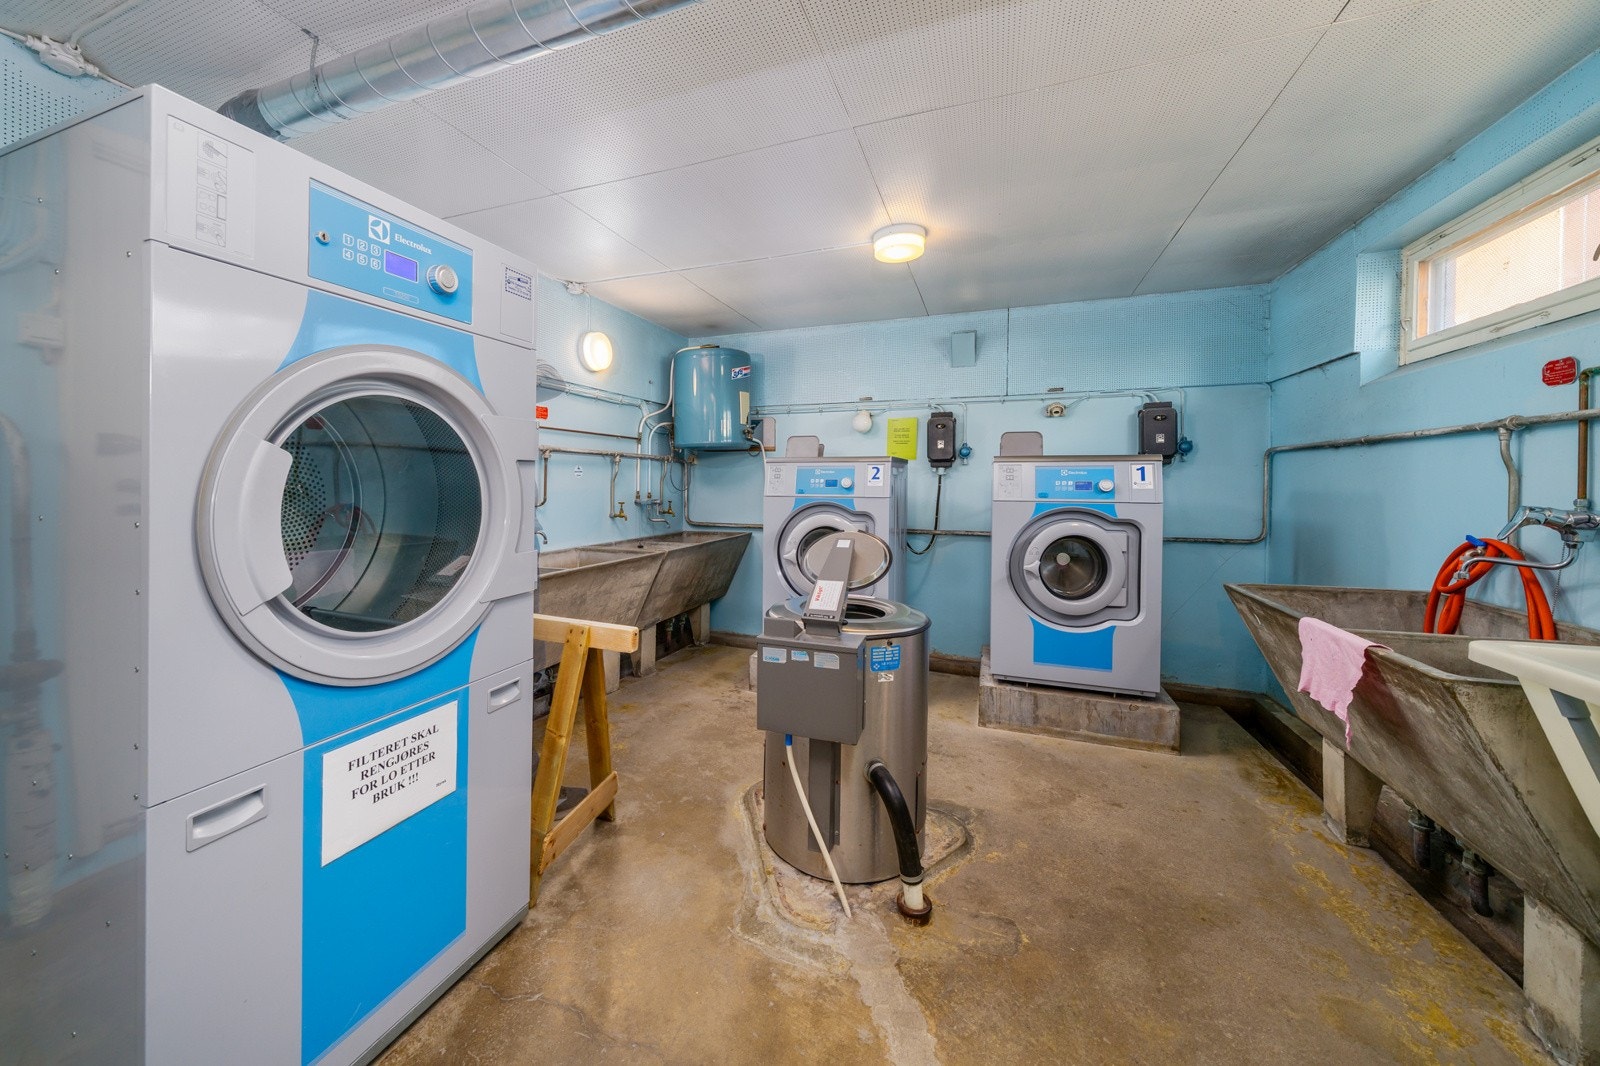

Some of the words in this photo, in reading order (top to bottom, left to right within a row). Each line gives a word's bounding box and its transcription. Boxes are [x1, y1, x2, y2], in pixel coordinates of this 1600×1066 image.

[394, 233, 432, 255] Electrolux
[871, 466, 880, 480] 2
[1136, 465, 1146, 482] 1
[348, 736, 409, 772] FILTERET
[410, 724, 440, 744] SKAL
[360, 741, 430, 781] RENGJØRES
[351, 779, 378, 800] FOR
[381, 769, 398, 786] LO
[400, 751, 437, 776] ETTER
[372, 779, 406, 804] BRUK
[408, 772, 419, 786] !!!
